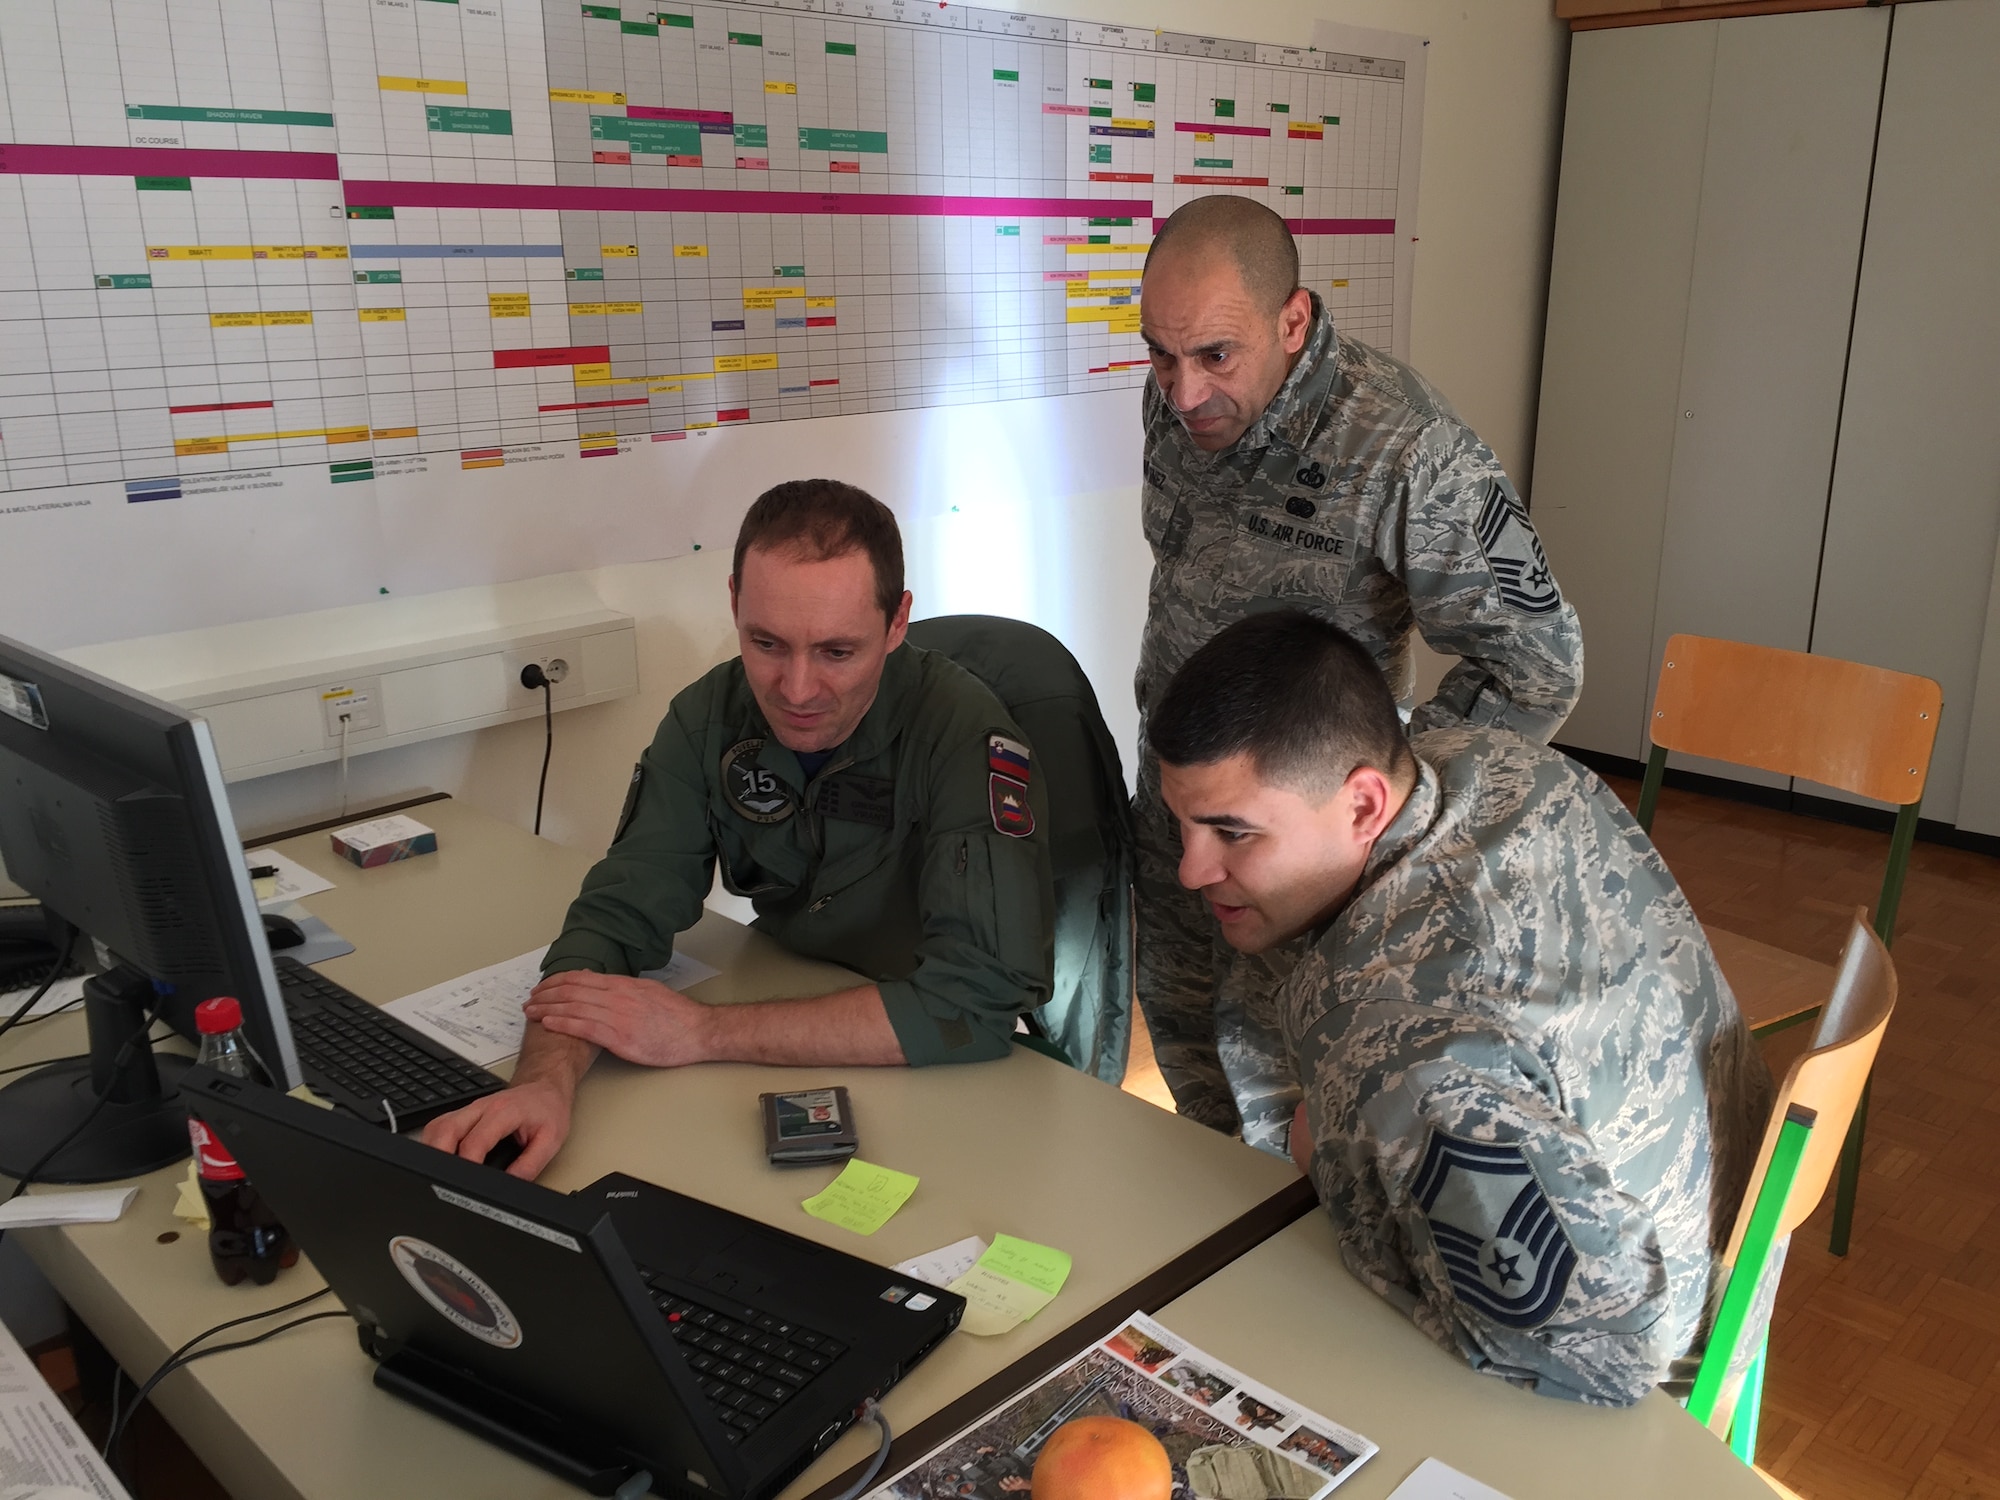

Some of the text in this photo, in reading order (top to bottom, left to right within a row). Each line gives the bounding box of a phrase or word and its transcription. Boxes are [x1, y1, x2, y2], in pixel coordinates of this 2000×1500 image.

[1101, 26, 1124, 34] SEPTEMBER
[148, 137, 180, 145] COURSE
[1248, 514, 1345, 555] U.S. AIR FORCE
[742, 769, 777, 794] 15
